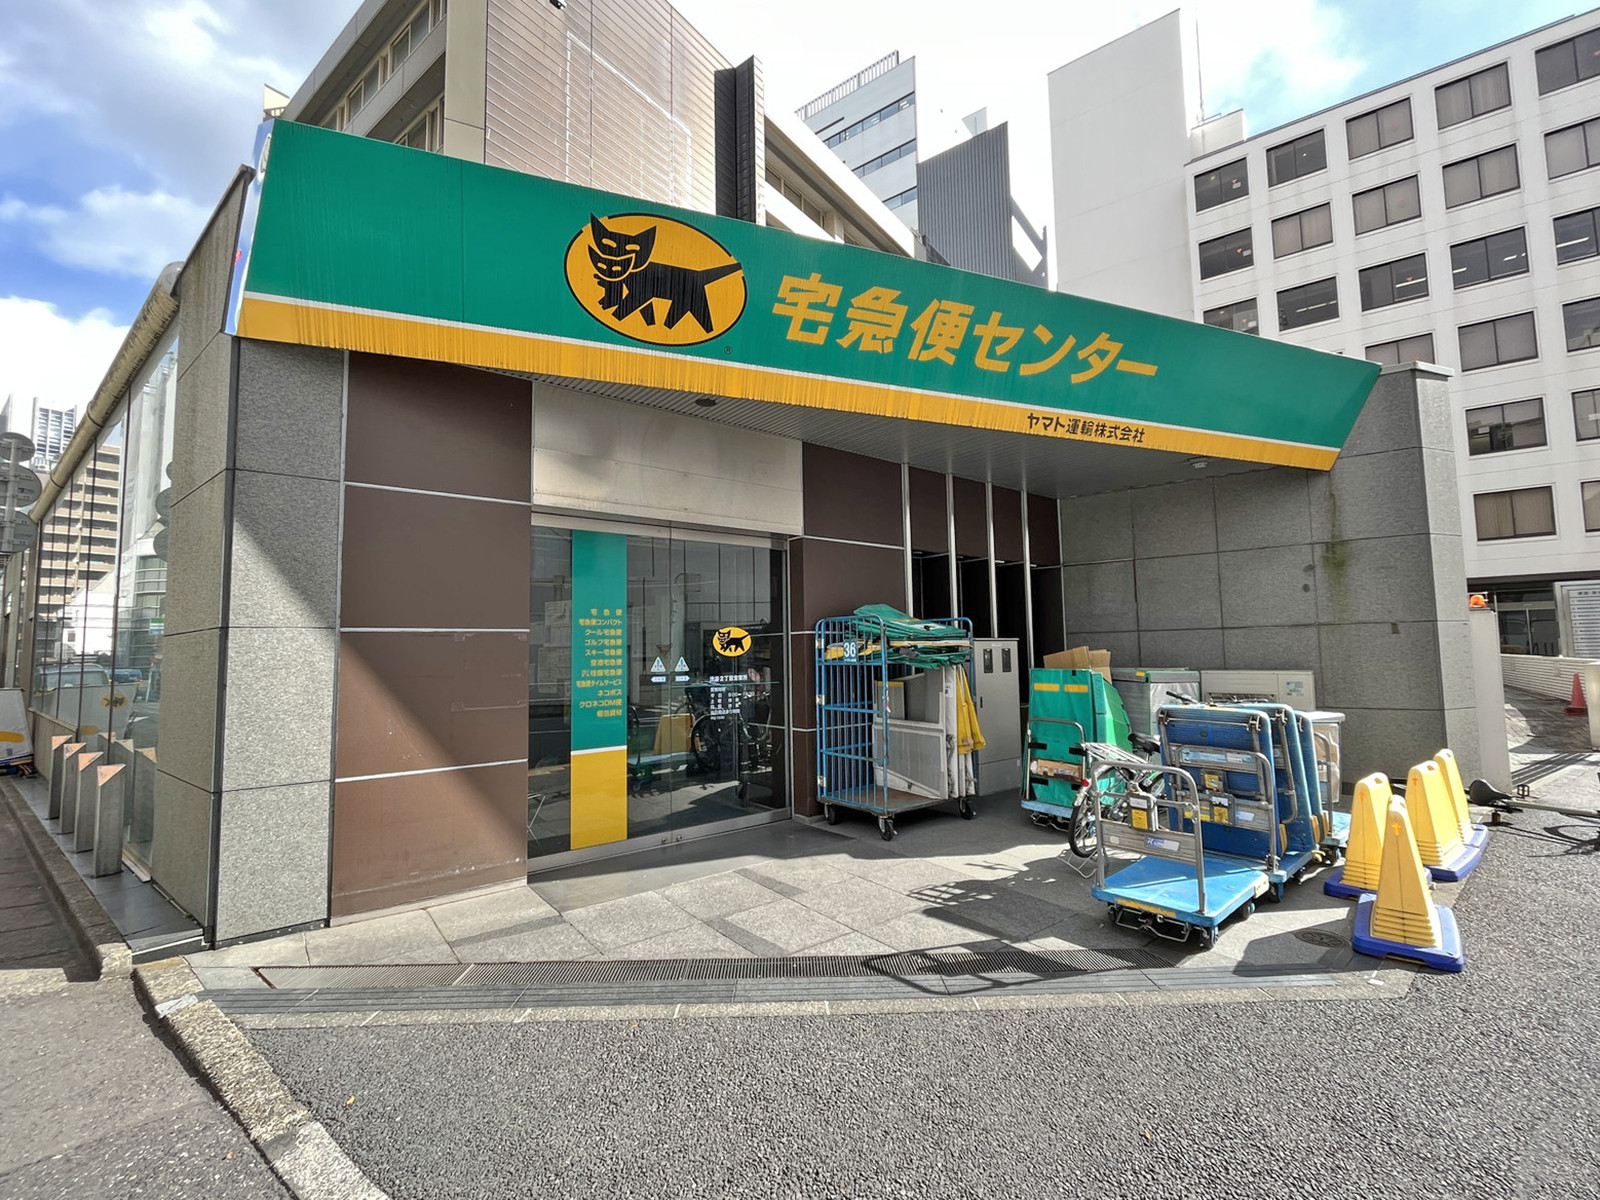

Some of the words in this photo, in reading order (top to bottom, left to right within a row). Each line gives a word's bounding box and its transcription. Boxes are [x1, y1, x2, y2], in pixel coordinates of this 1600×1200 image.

[772, 273, 1158, 384] 宅急便センター
[1027, 412, 1145, 443] ヤマト運輸株式会社
[585, 628, 622, 636] クール宅急便
[585, 638, 622, 646] ゴルフ宅急便
[585, 648, 622, 656] スキー宅急便
[843, 642, 856, 657] 36
[597, 689, 622, 697] ネコポス
[579, 699, 622, 708] クロネコDM便
